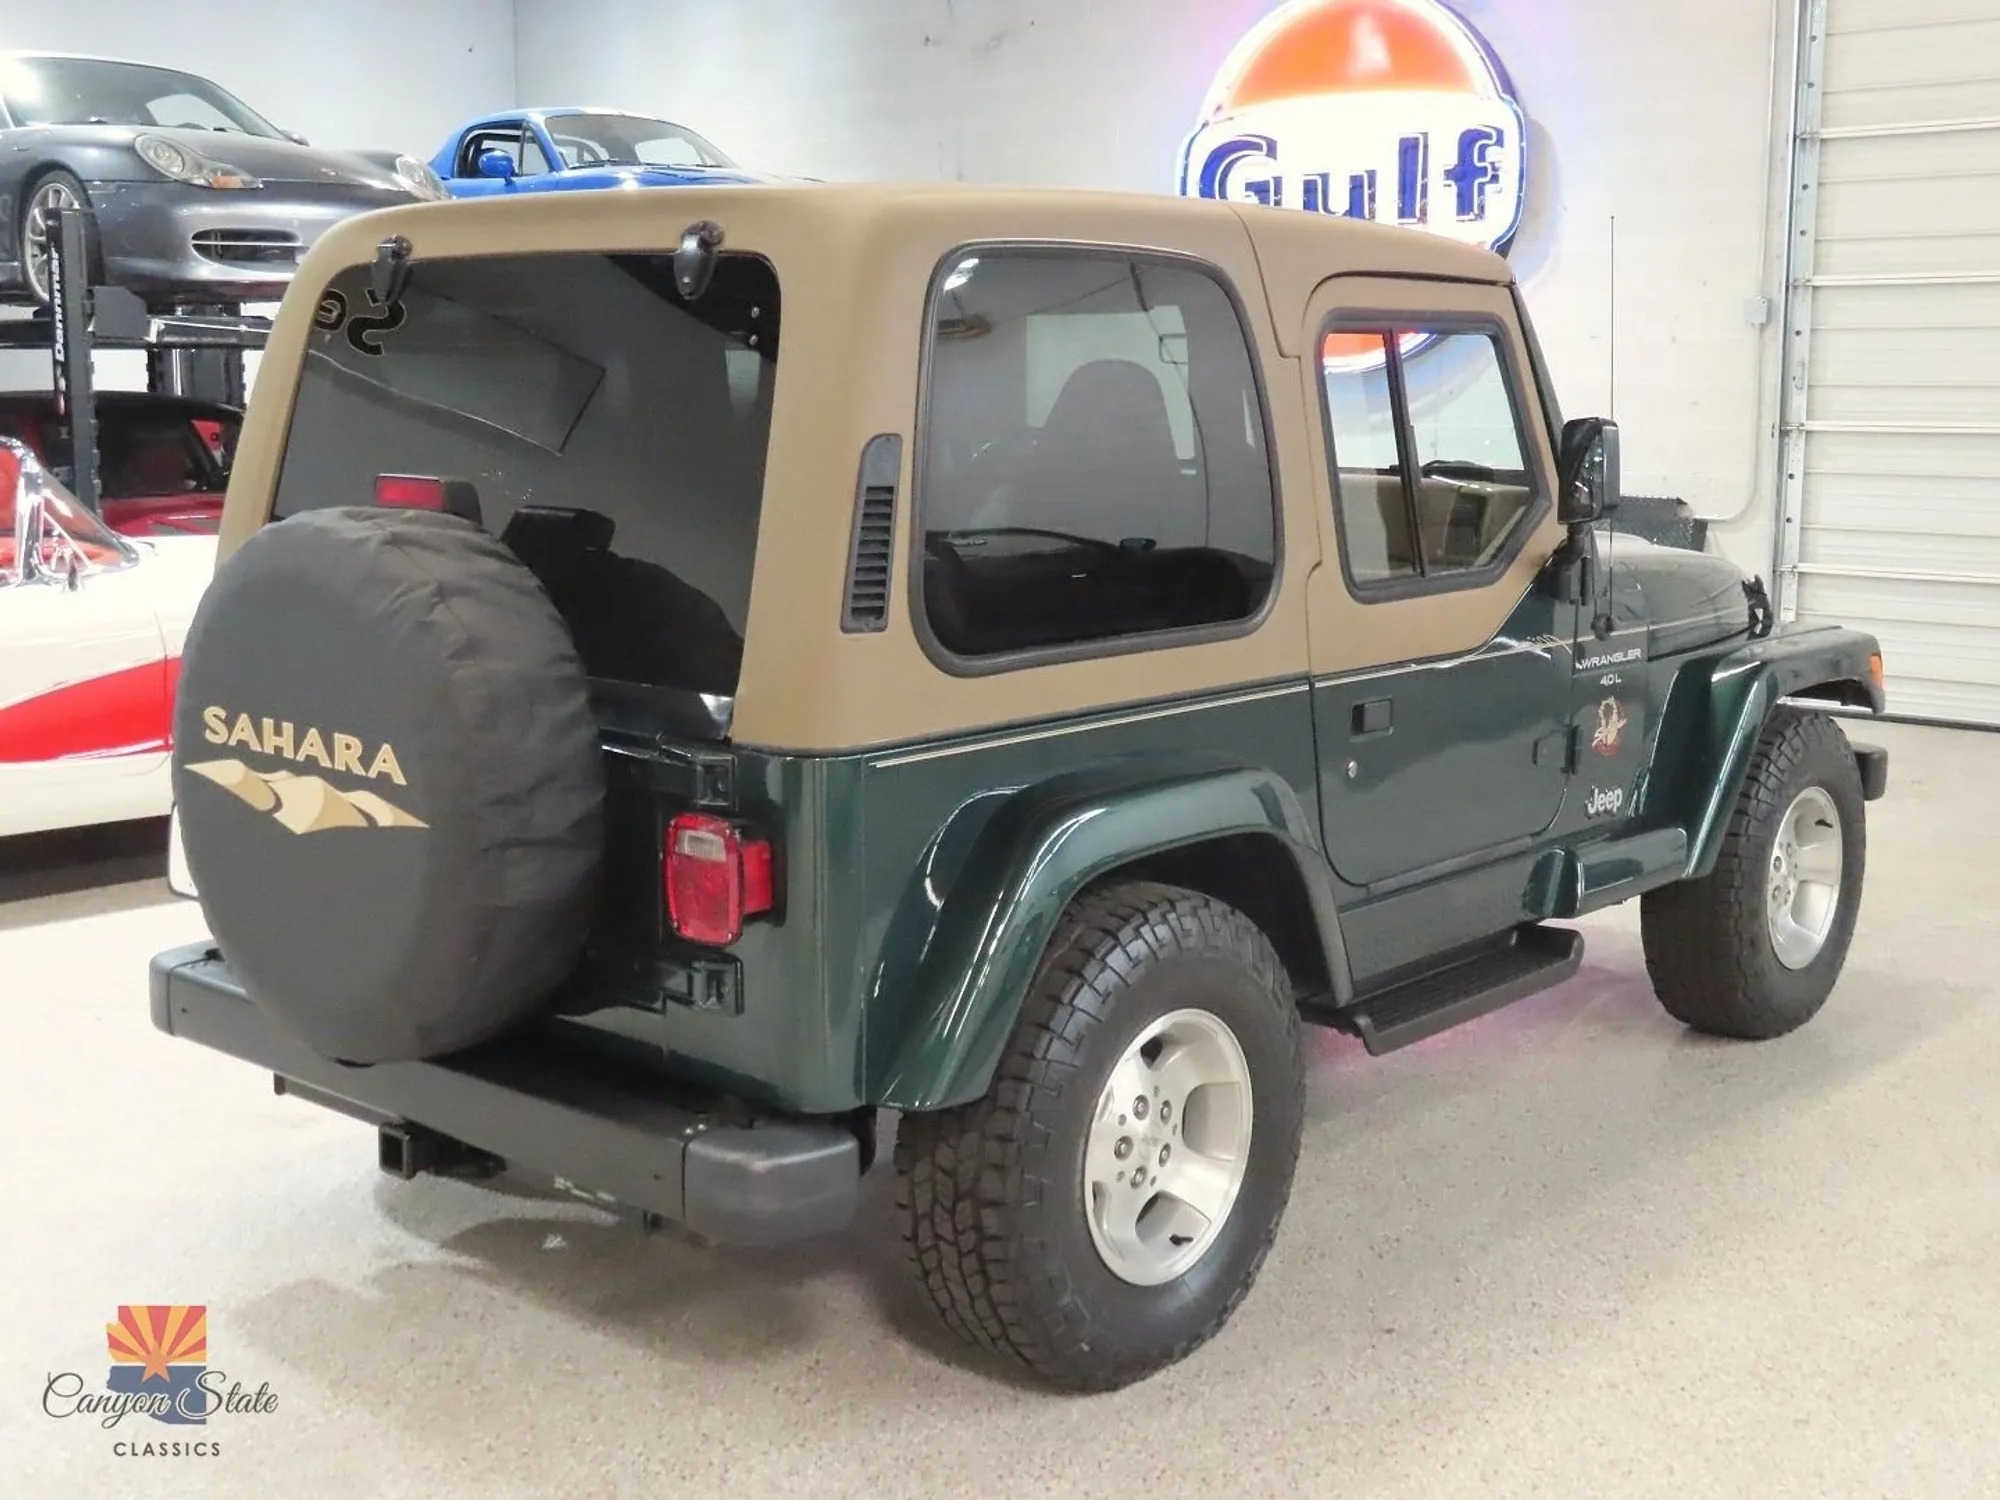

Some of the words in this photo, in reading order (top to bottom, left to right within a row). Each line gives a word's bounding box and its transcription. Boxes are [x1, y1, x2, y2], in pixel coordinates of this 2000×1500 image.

[1198, 125, 1504, 225] Gulf
[50, 246, 66, 363] Dannmar
[1576, 648, 1642, 670] WRANGLER
[203, 706, 408, 786] SAHARA
[1587, 787, 1623, 814] Jeep
